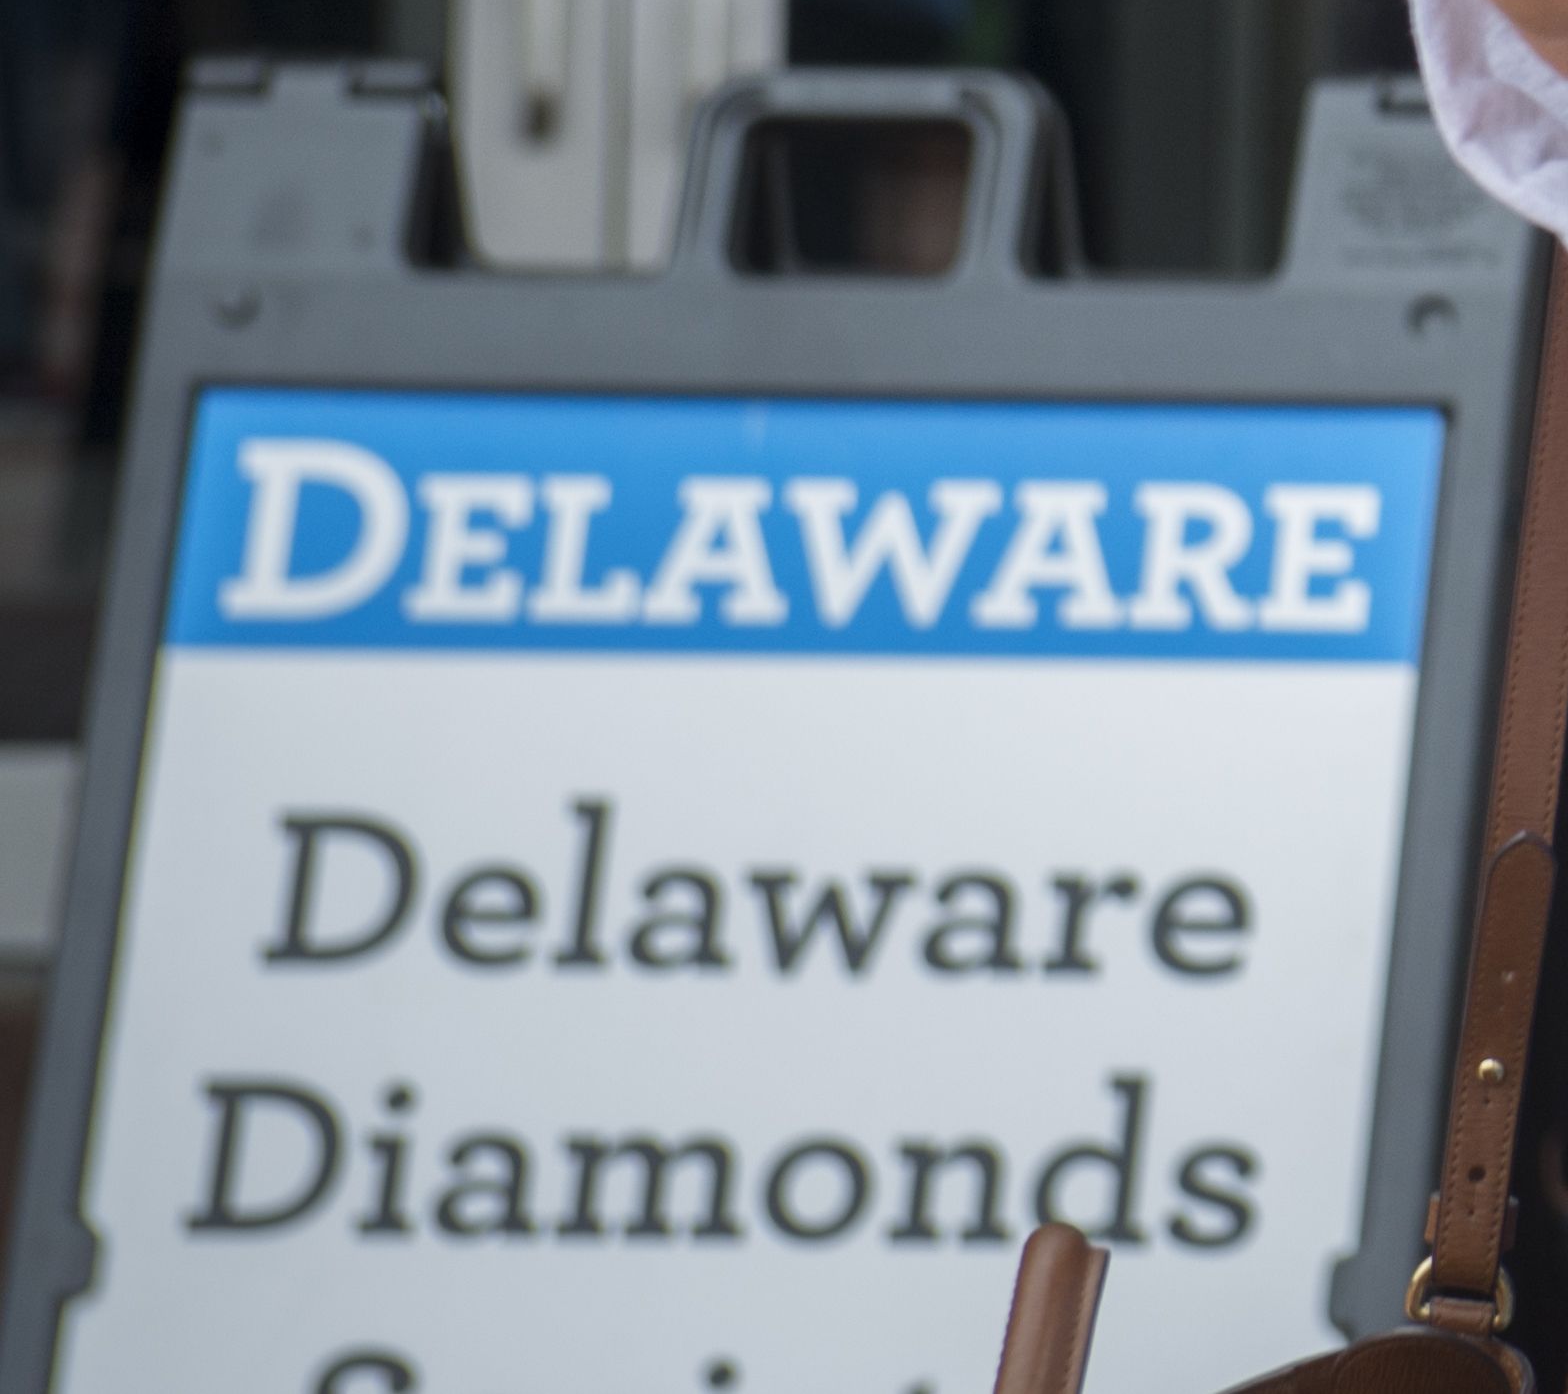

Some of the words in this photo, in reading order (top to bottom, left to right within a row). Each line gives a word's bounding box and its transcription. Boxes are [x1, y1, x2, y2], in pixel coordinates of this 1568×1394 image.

[218, 435, 1383, 633] DELAWARE
[256, 792, 1256, 980] Delaware
[183, 1070, 1263, 1252] Diamonds
